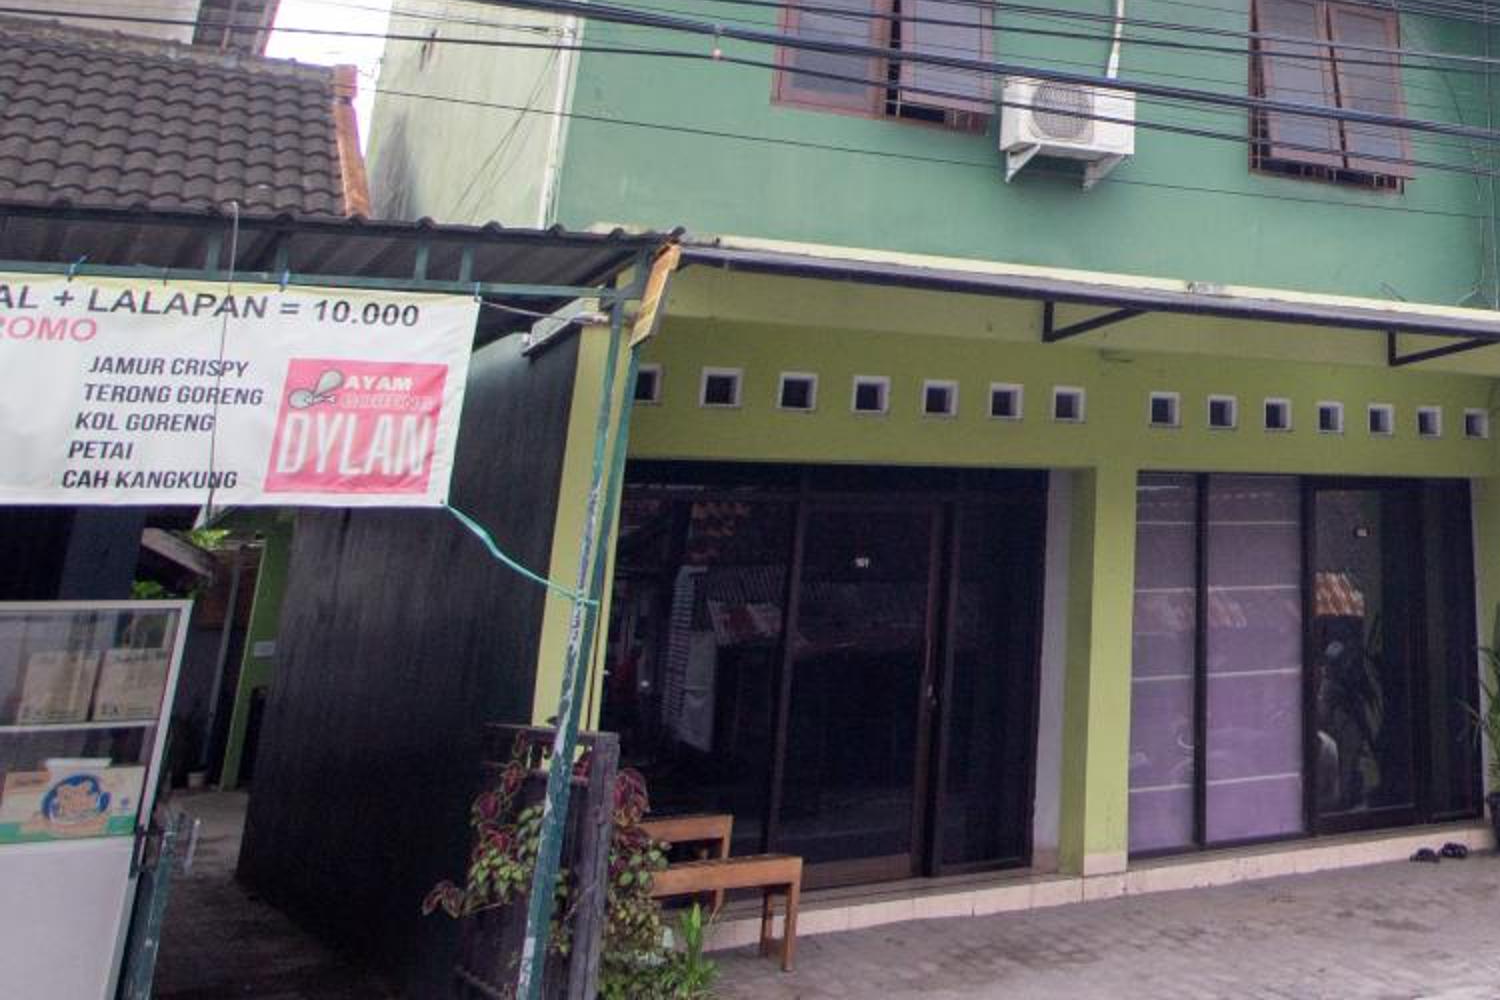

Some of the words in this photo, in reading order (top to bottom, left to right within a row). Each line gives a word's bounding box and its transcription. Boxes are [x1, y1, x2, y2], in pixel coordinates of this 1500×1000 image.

[88, 288, 269, 319] LALAPAN
[314, 299, 419, 326] 10.000
[0, 316, 97, 341] OMO
[88, 356, 164, 375] JAMUR
[171, 358, 249, 378] CRISPY
[84, 383, 171, 403] TERONG
[177, 385, 264, 405] GORENG
[344, 376, 413, 391] AYAM
[75, 412, 118, 431] KOL
[125, 413, 216, 432] GORENG
[67, 440, 134, 460] PETAI
[276, 411, 433, 476] DYLAN
[61, 469, 109, 489] CAH
[115, 471, 238, 489] KANGKUNG
